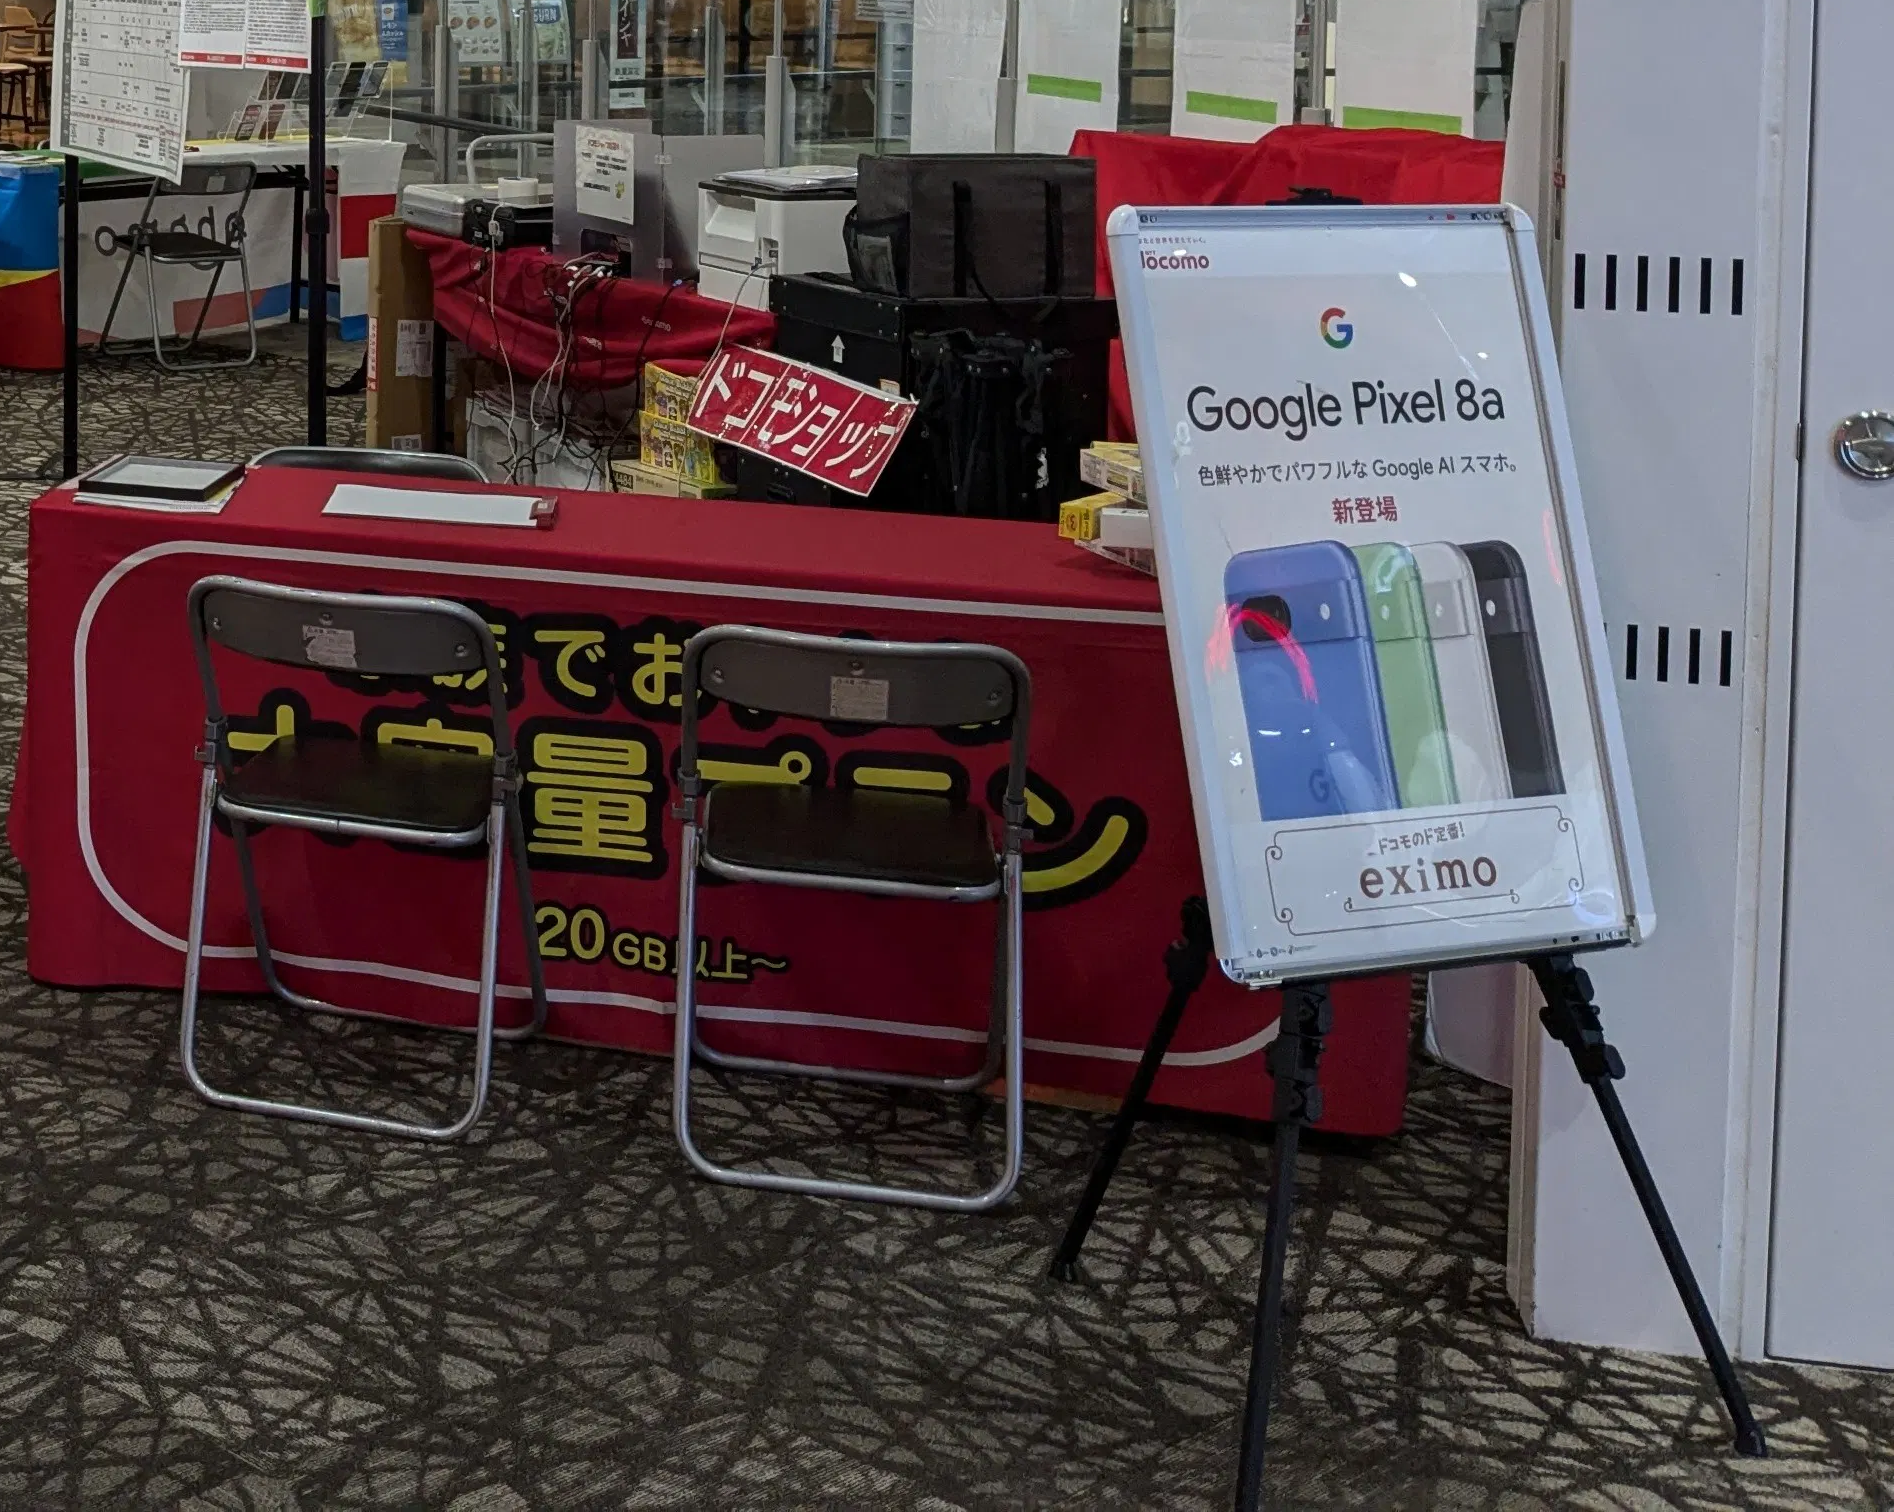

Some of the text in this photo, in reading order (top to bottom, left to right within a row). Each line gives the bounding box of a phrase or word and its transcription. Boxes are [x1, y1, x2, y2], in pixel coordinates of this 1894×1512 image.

[694, 353, 906, 479] ドコモショップ
[1186, 377, 1506, 442] Google Pixel 8a
[1197, 453, 1517, 489] 色鮮やかでパワフルな Google AI スマホ。
[1331, 495, 1399, 526] 新登場
[1359, 856, 1498, 899] eximo
